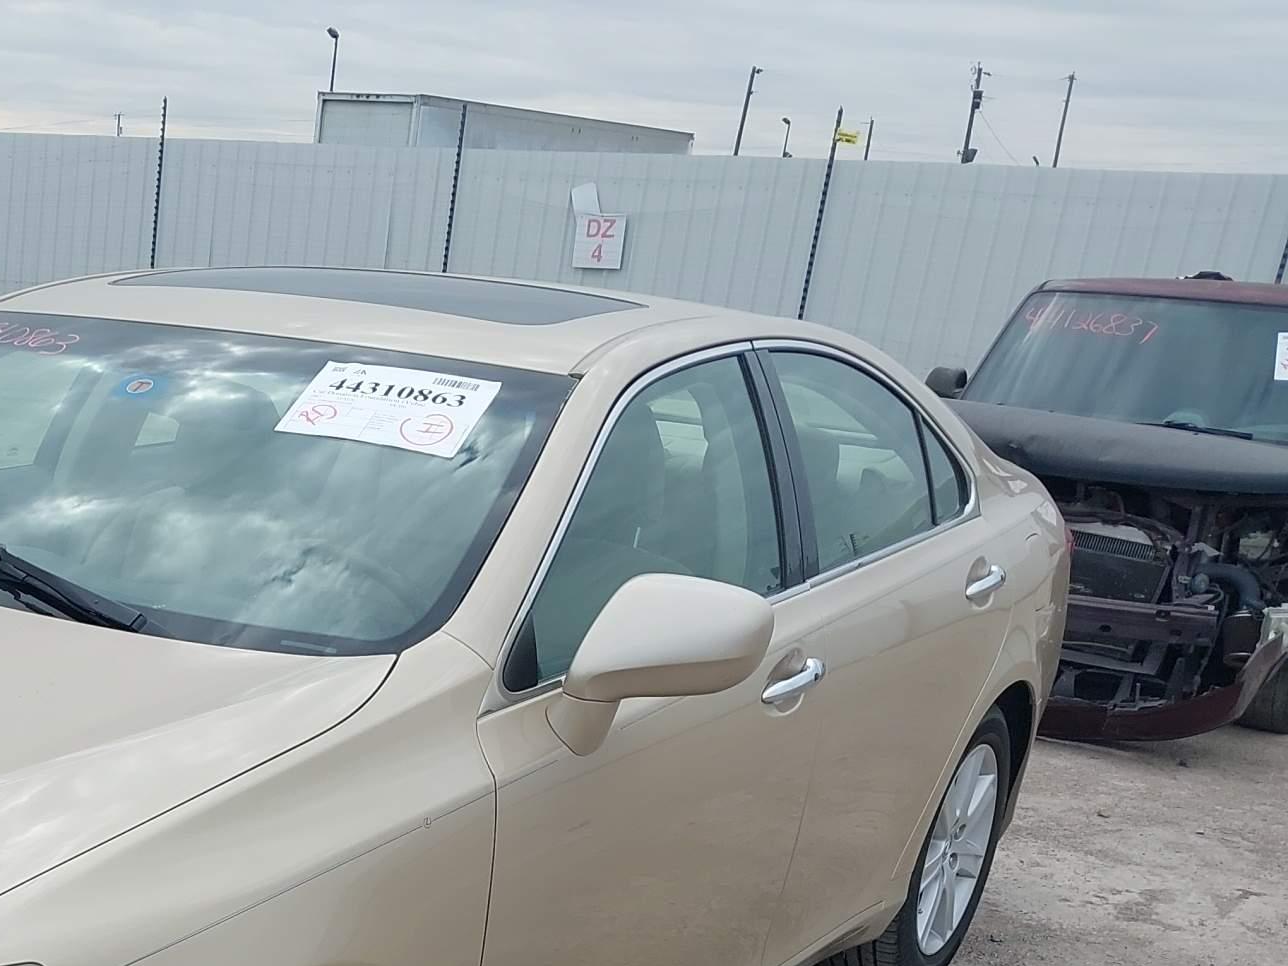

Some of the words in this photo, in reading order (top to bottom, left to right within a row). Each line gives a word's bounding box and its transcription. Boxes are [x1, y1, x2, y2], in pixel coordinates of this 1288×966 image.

[586, 218, 617, 238] DZ
[591, 243, 603, 262] 4
[328, 378, 467, 408] 44310863
